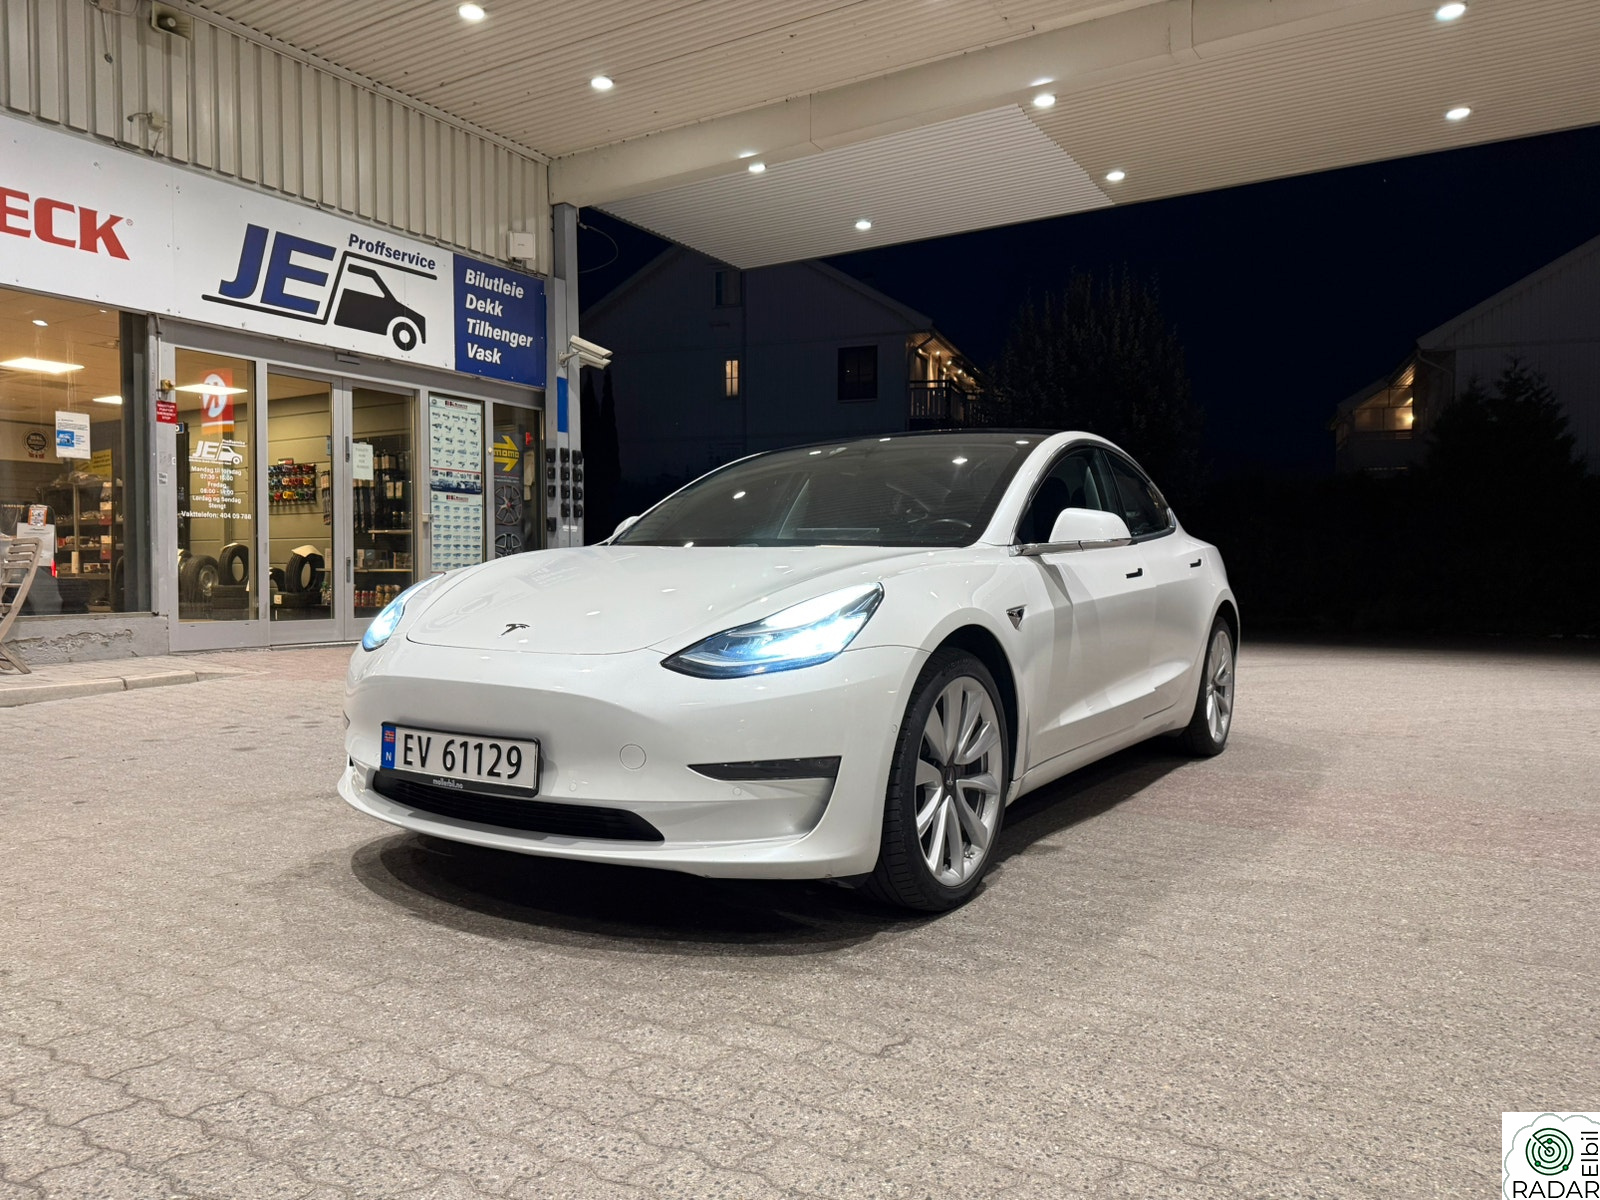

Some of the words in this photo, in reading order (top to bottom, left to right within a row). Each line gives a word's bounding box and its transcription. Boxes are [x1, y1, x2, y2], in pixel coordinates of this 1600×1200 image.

[0, 186, 130, 261] ECK
[348, 233, 437, 271] Proffservice
[218, 223, 337, 315] JE
[465, 268, 524, 299] Bilutleie
[465, 293, 504, 317] Dekk
[466, 318, 533, 348] Tilhenger
[467, 342, 502, 364] Vask
[192, 440, 220, 458] JE
[191, 466, 214, 474] Mandag
[385, 751, 392, 761] N
[403, 733, 432, 768] EV
[442, 739, 522, 779] 61129
